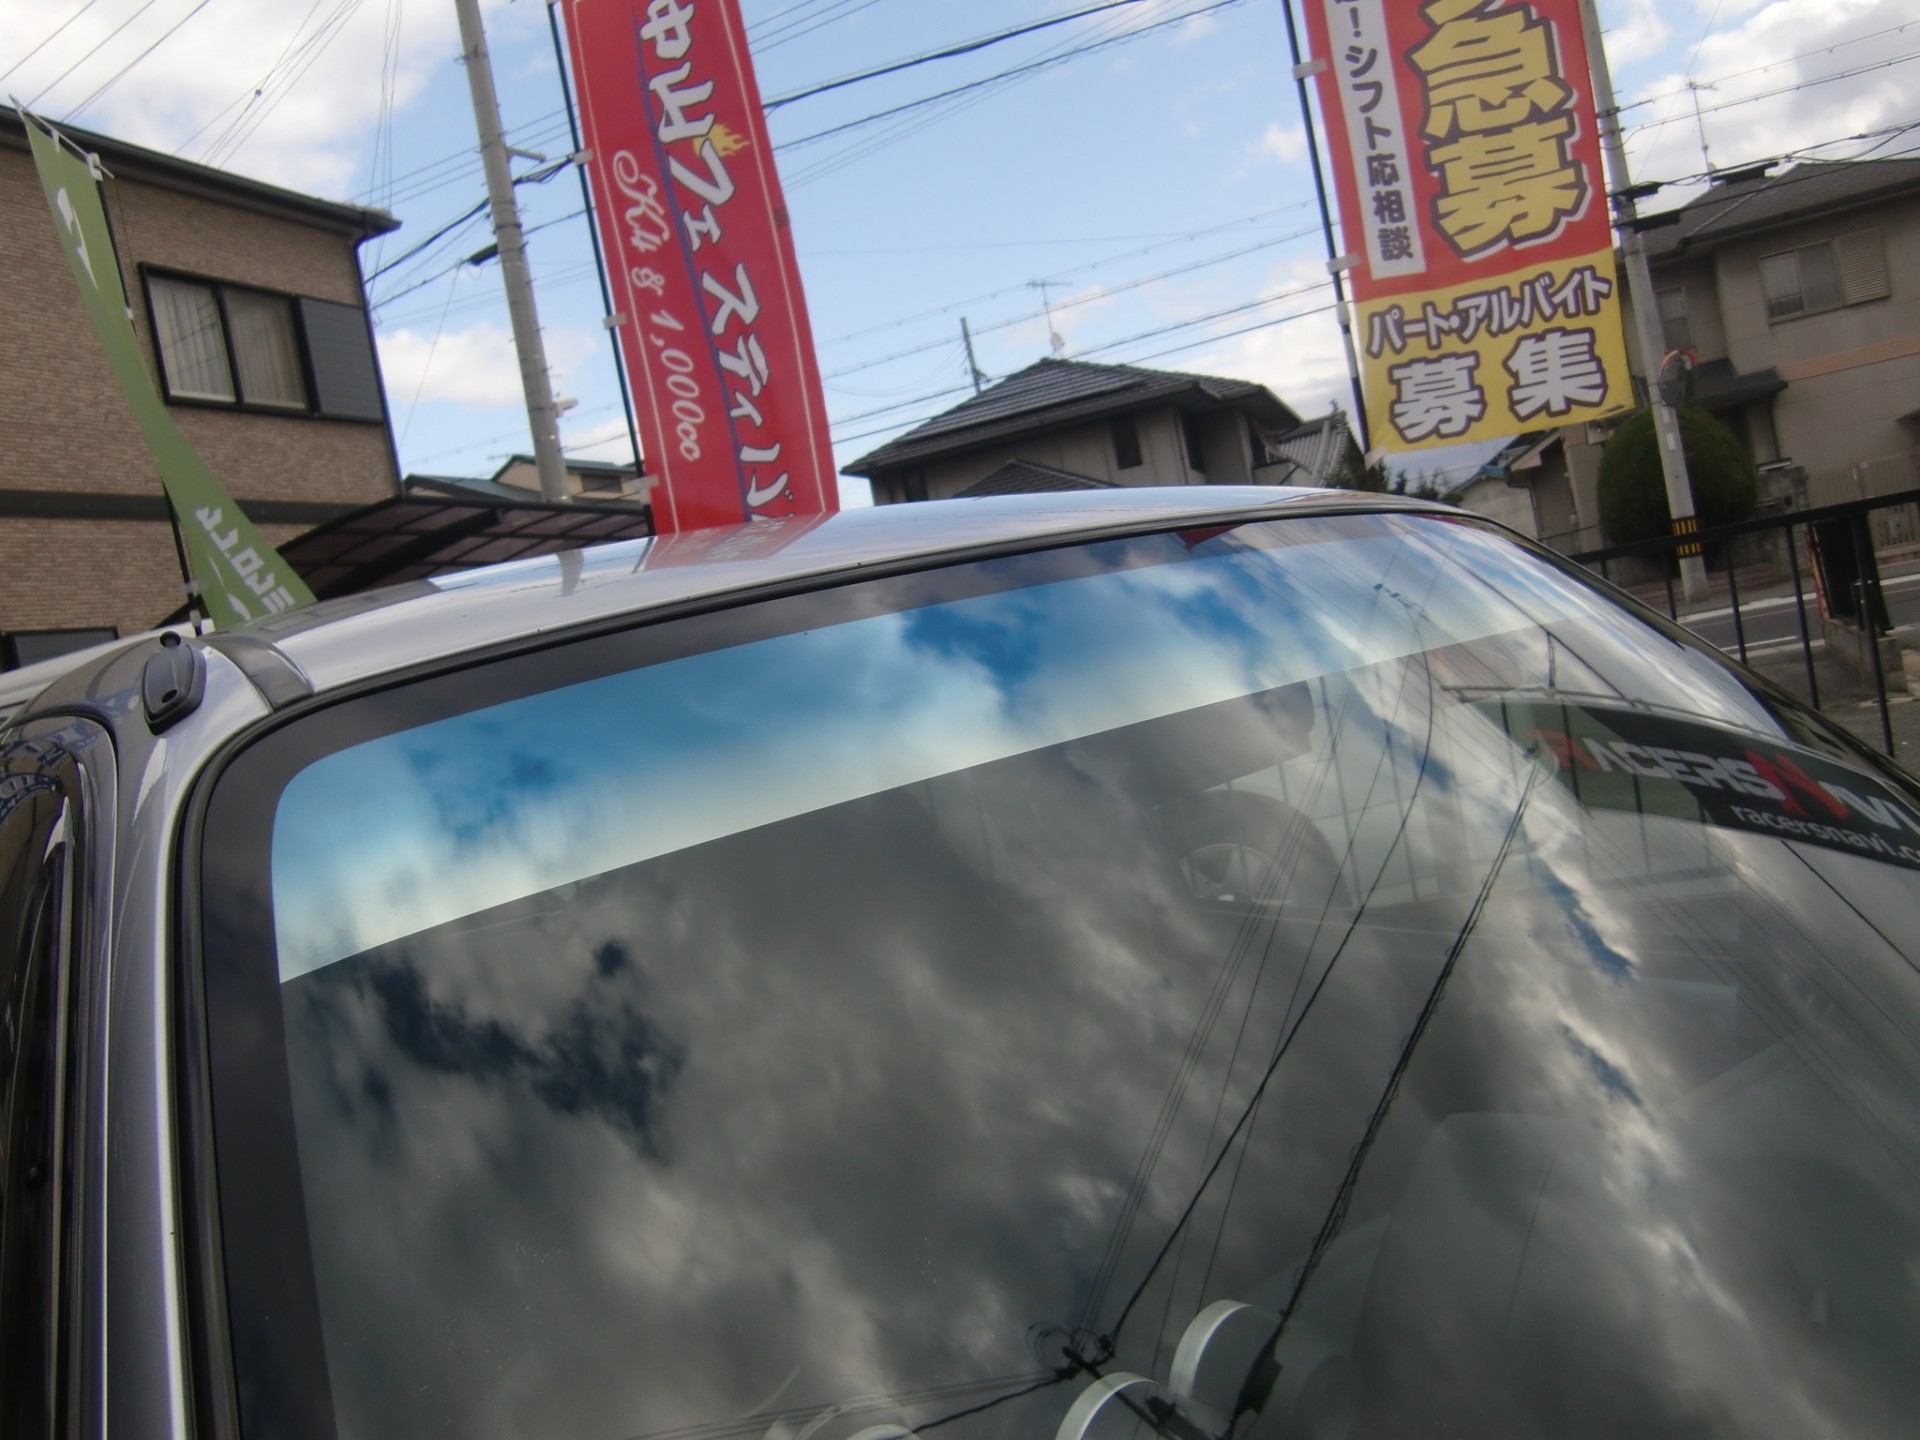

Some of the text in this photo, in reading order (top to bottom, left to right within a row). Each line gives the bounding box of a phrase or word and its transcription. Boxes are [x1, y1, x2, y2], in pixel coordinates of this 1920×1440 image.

[1404, 0, 1590, 260] 急募
[631, 267, 665, 297] &
[650, 309, 706, 463] 1,000cc
[1366, 265, 1612, 358] パート・アルバイト
[1387, 327, 1608, 443] 募集
